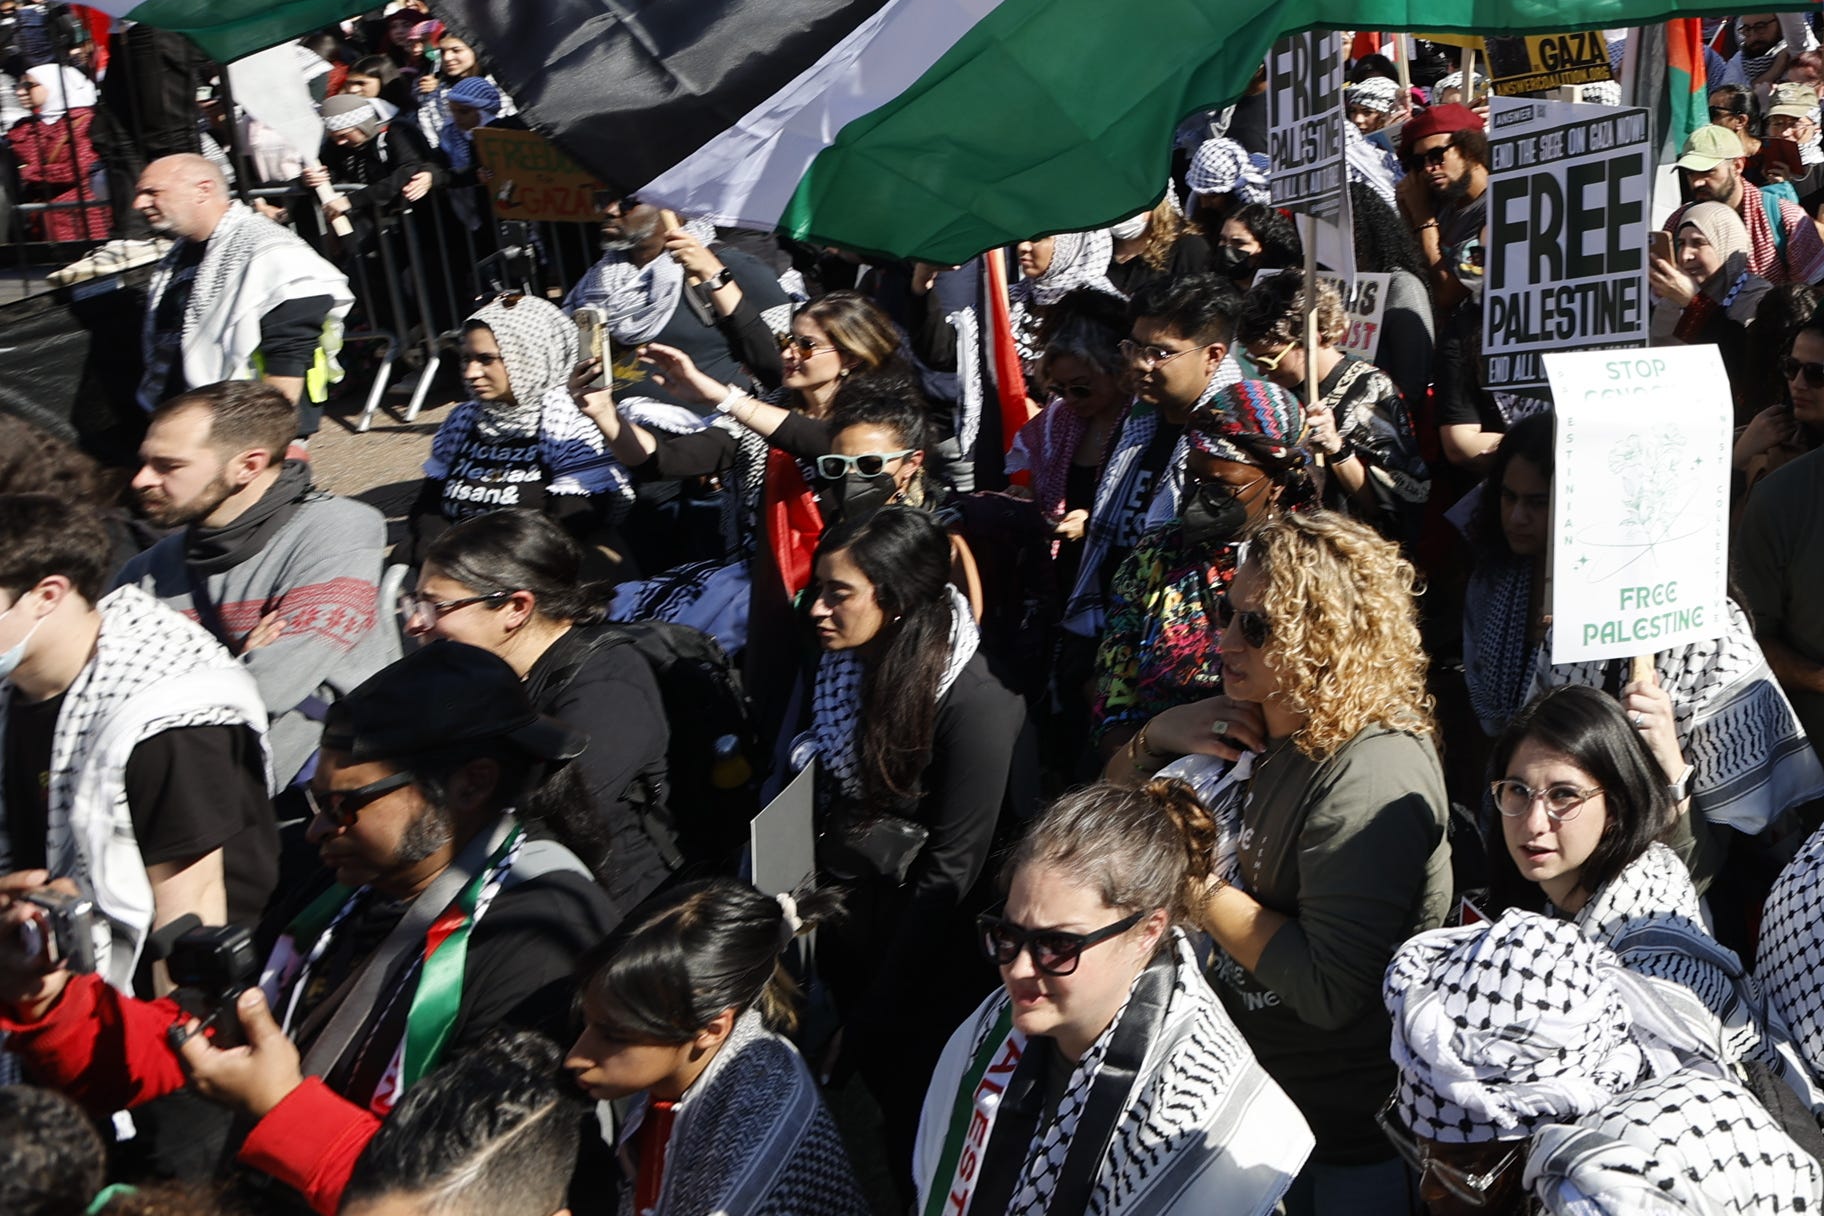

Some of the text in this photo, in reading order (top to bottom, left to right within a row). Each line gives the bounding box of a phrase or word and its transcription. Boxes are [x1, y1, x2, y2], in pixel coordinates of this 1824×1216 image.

[1538, 31, 1606, 72] GAZA
[1495, 104, 1534, 127] ANSWER
[1492, 142, 1515, 171] END
[1517, 137, 1537, 166] THE
[1539, 131, 1565, 162] SIEGE
[1567, 126, 1586, 156] ON
[1589, 120, 1614, 151] GAZA
[520, 186, 592, 215] GAZA
[1490, 152, 1646, 289] FREE
[1488, 276, 1641, 348] PALESTINE!
[1488, 353, 1537, 384] END ALL
[1605, 358, 1667, 381] STOP
[1620, 580, 1678, 611] FREE
[1582, 605, 1705, 647] PALESTINE
